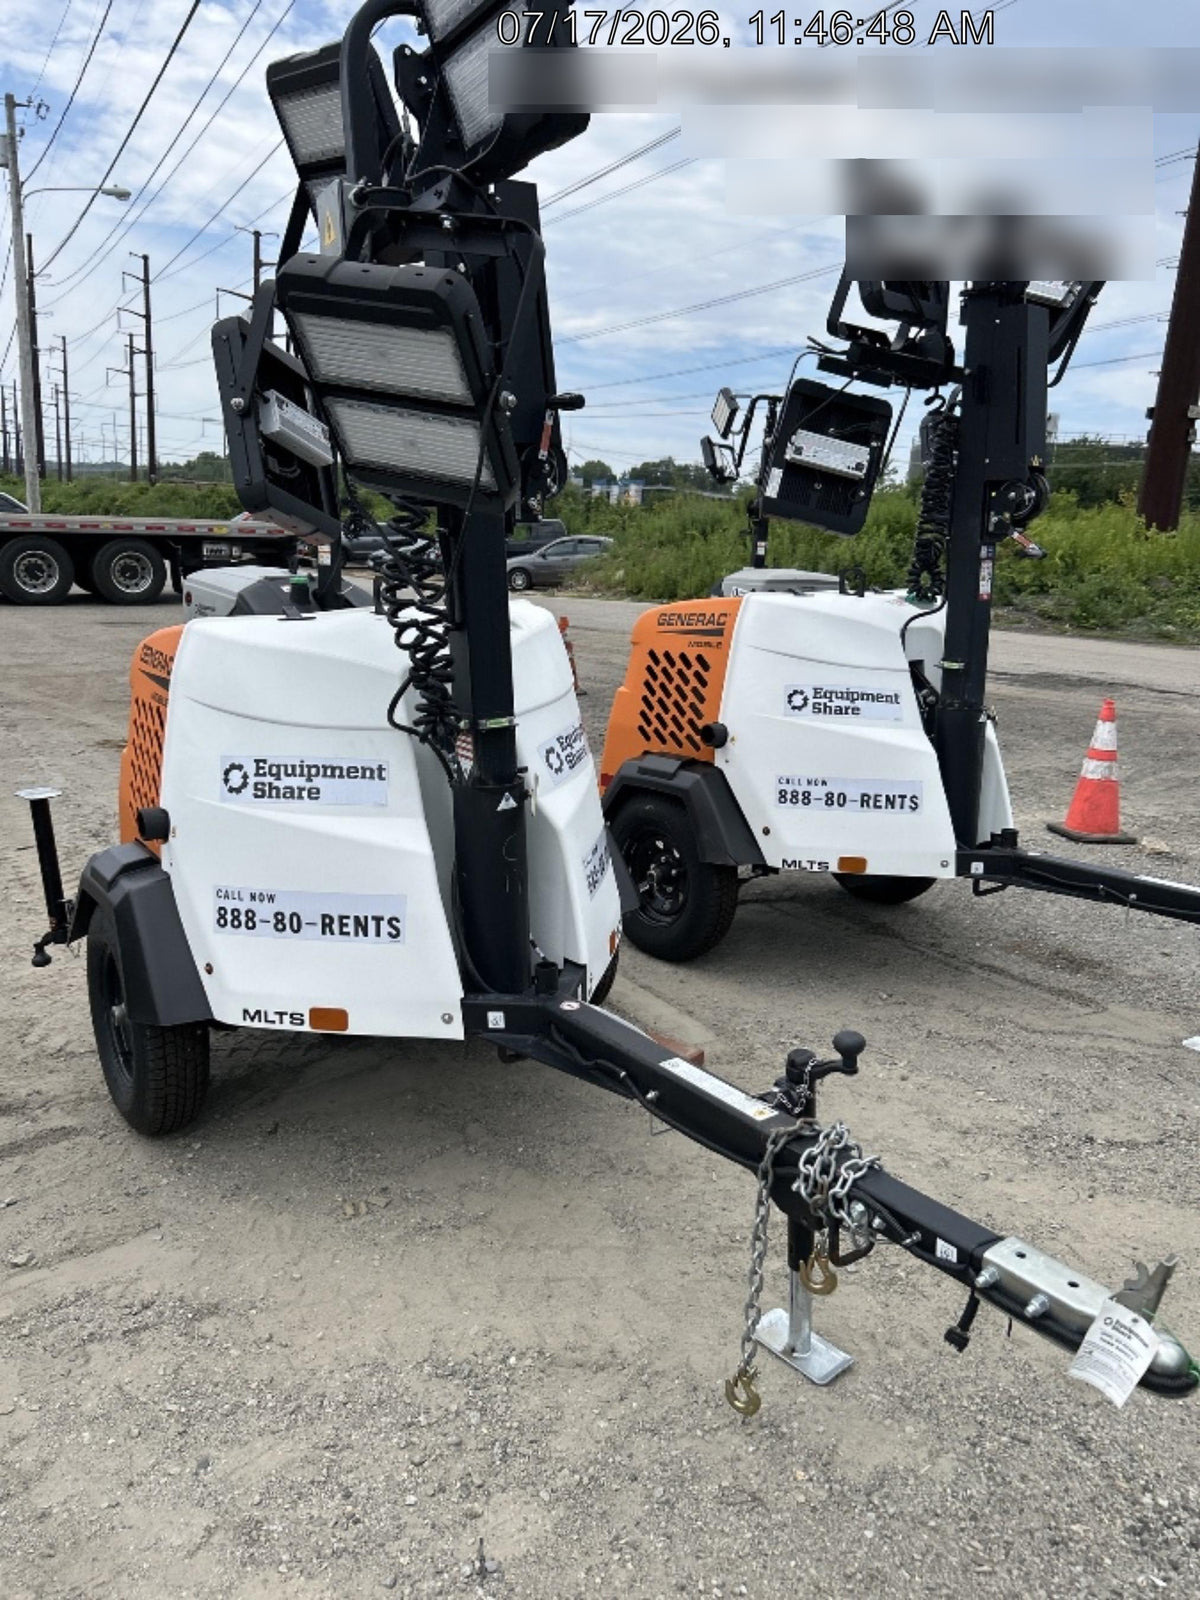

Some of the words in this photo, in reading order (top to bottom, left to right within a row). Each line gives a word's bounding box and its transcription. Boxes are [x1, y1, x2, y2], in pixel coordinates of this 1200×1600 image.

[657, 612, 728, 627] GENERAC
[812, 687, 900, 705] Equipment
[811, 701, 861, 716] Share
[253, 758, 387, 783] Equipment
[252, 781, 321, 801] Share
[777, 788, 920, 812] 888-80-RENTS
[781, 858, 830, 870] MLTS
[216, 888, 244, 902] CALL
[249, 891, 276, 904] NOW
[216, 906, 401, 940] 888-80-RENTS
[242, 1008, 305, 1027] MLTS
